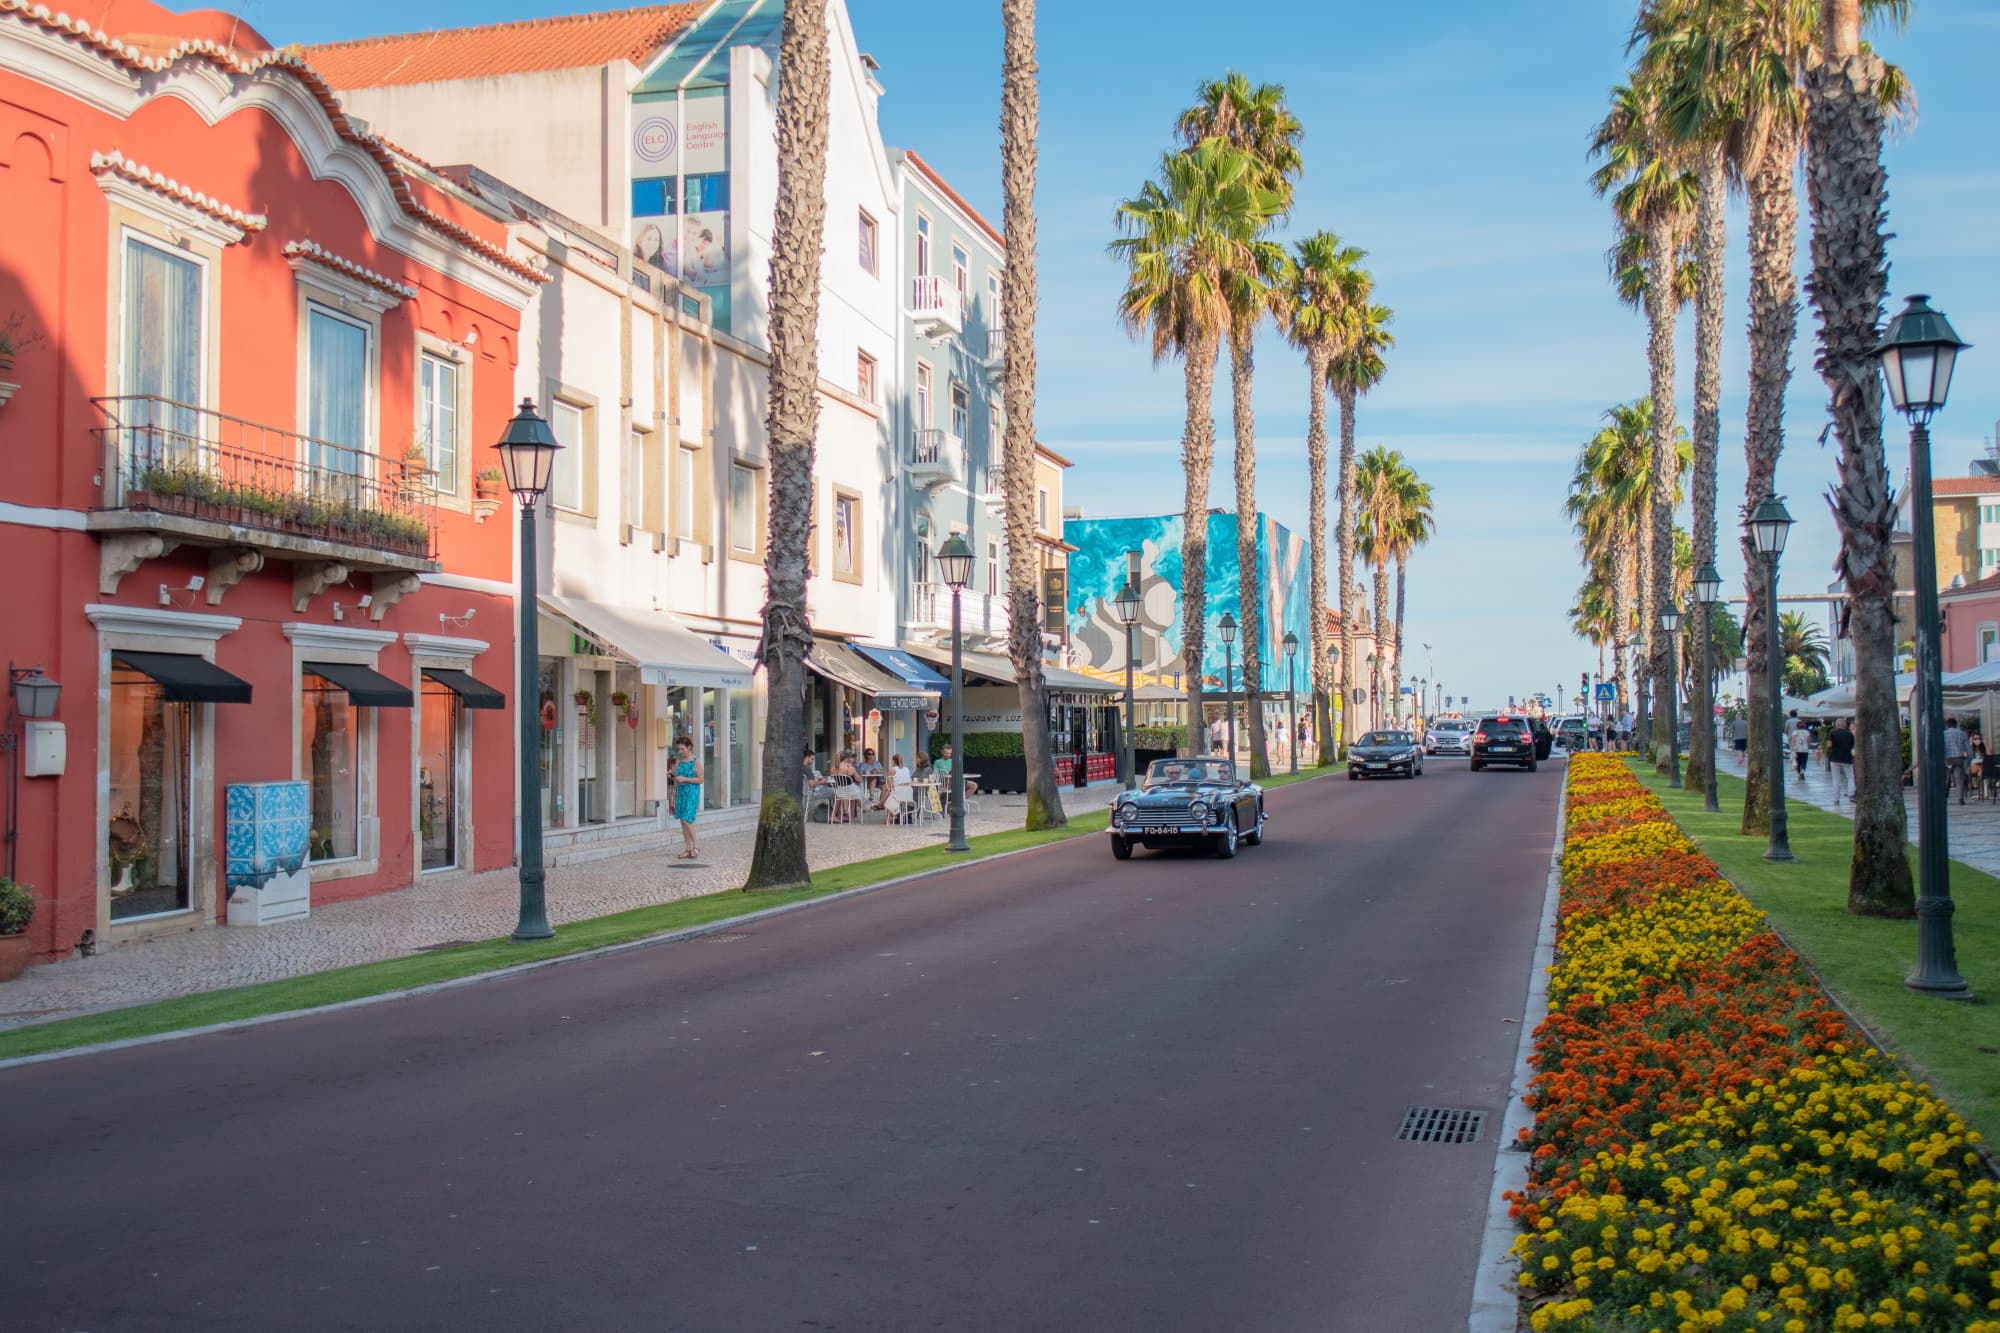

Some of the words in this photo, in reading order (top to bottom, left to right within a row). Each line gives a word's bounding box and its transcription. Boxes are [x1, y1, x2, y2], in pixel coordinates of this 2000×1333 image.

[686, 122, 718, 132] English
[644, 135, 665, 145] ELC
[686, 131, 729, 141] Language
[686, 141, 715, 150] Centre
